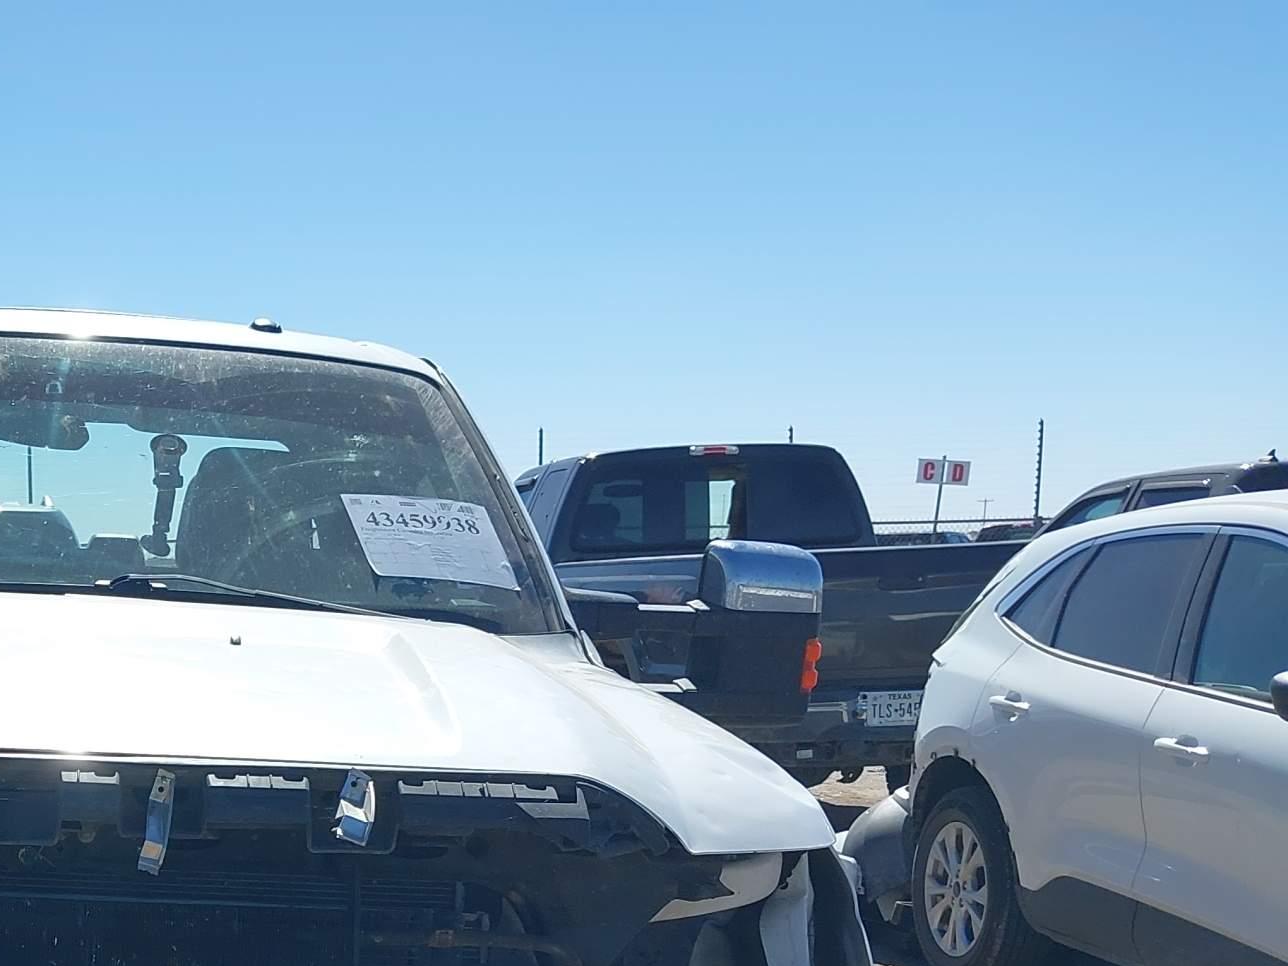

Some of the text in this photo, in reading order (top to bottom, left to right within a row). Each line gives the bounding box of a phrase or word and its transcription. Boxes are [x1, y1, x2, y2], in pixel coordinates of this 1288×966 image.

[923, 462, 936, 481] C
[951, 463, 964, 482] D
[365, 511, 481, 535] 43459938
[887, 693, 913, 701] TEXAS
